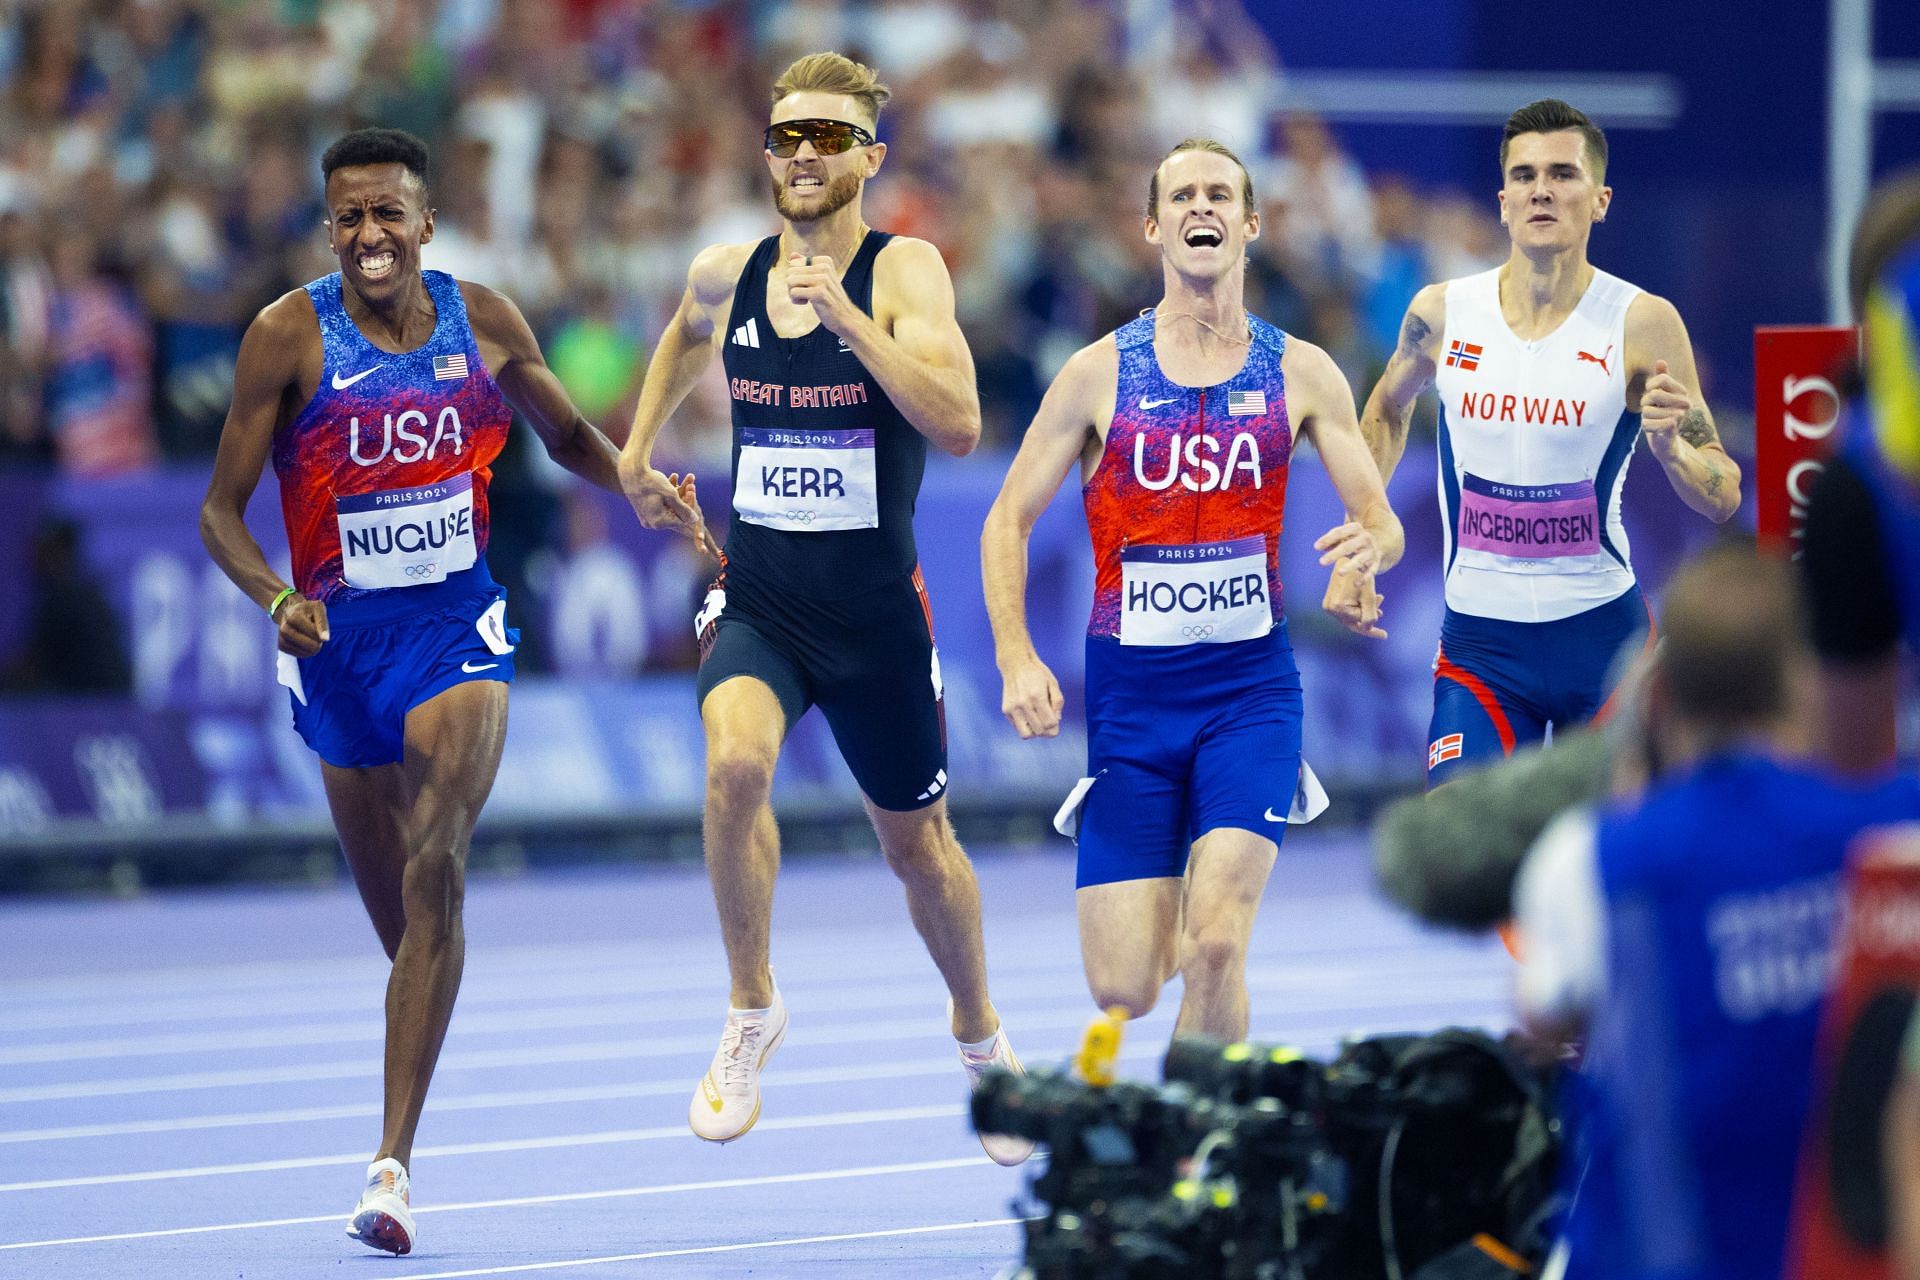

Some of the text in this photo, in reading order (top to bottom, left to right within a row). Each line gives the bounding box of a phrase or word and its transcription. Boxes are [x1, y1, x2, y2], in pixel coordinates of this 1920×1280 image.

[731, 377, 867, 408] GREAT BRITAIN
[1461, 392, 1586, 427] NORWAY
[350, 406, 463, 466] USA
[768, 433, 836, 444] PARIS 2024
[1134, 432, 1262, 492] USA
[415, 487, 447, 501] 2024
[762, 466, 846, 497] KERR
[1492, 486, 1561, 498] PARIS 2024
[347, 506, 471, 557] NUGUSE
[1462, 506, 1593, 545] INGEBRIGTSEN
[1158, 546, 1232, 559] PARIS 2024
[1128, 573, 1266, 613] HOCKER
